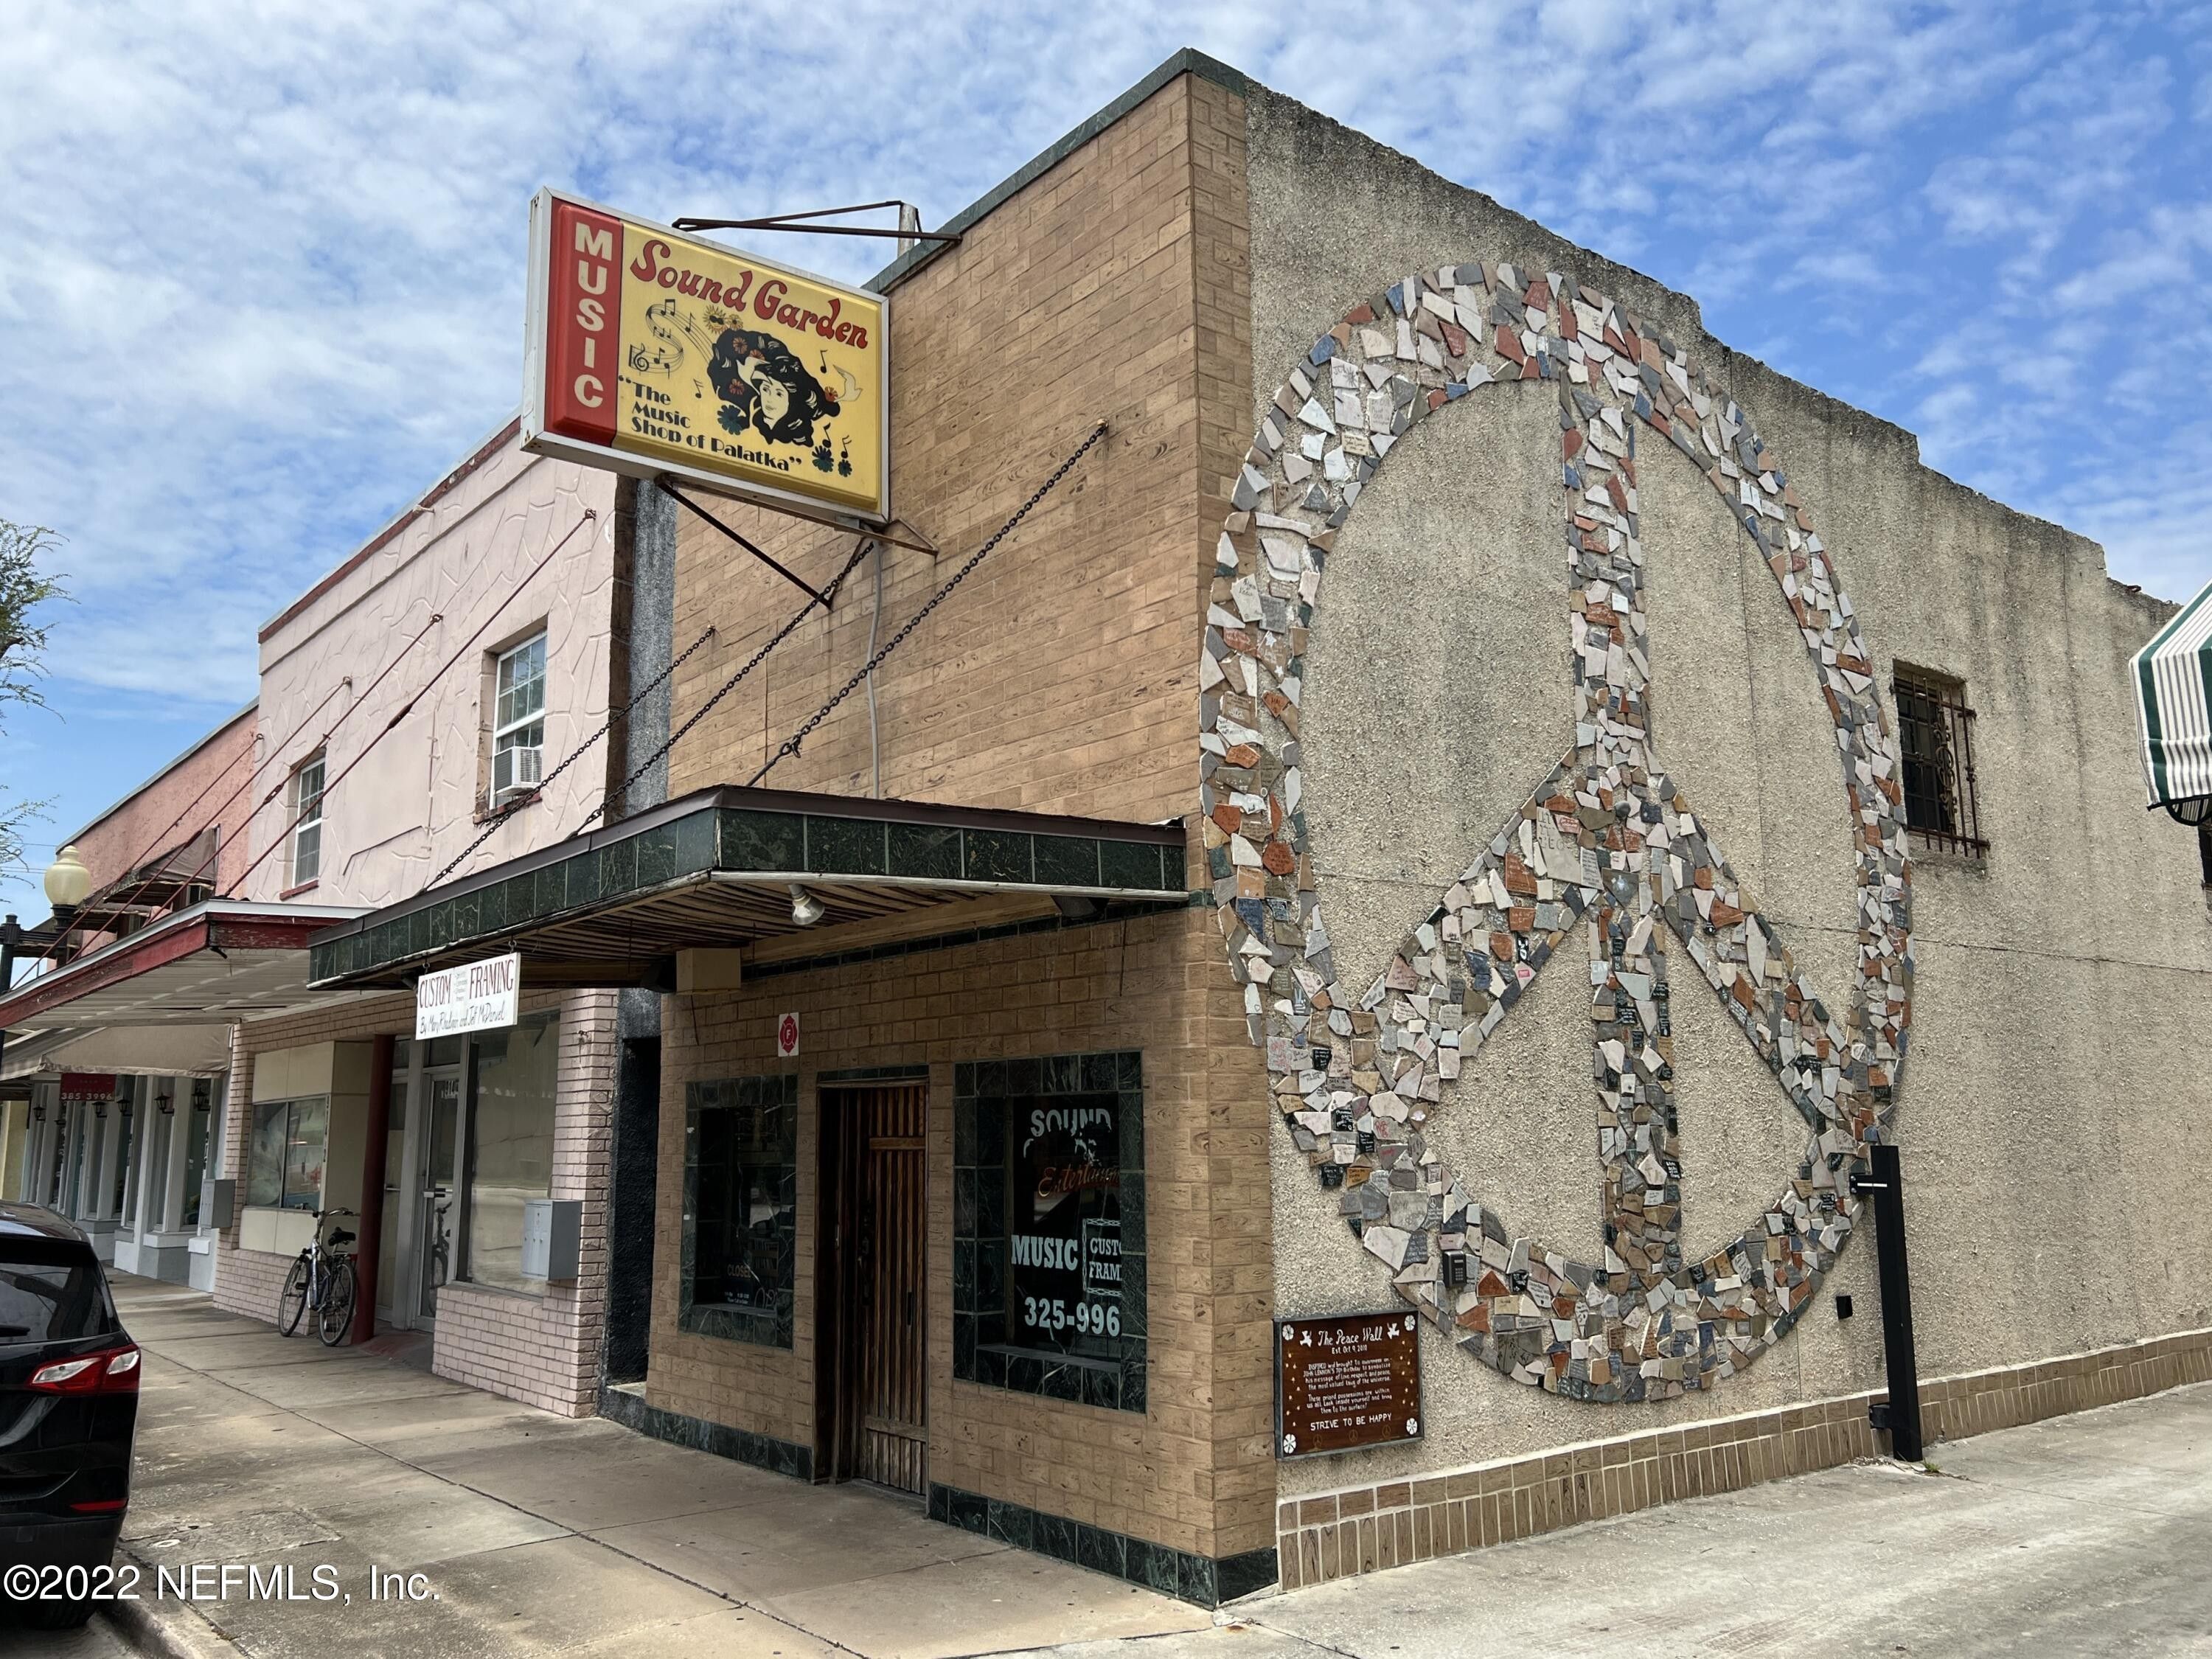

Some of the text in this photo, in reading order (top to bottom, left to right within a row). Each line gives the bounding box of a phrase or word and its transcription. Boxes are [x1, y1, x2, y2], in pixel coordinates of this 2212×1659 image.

[630, 240, 869, 349] Sound Garden
[574, 222, 613, 408] MUSIC
[632, 401, 691, 428] Music
[631, 417, 681, 445] Shop
[687, 434, 706, 449] of
[420, 974, 451, 1008] CUSTOM
[469, 959, 515, 1000] FRAMING
[786, 1029, 791, 1040] F
[61, 1092, 112, 1101] 385 3996
[1011, 1235, 1078, 1270] MUSIC
[1089, 1261, 1121, 1281] FRAM
[1025, 1297, 1120, 1337] 325-996
[1318, 1326, 1382, 1346] The Peace Wall
[1310, 1413, 1392, 1431] STRIVE TO BE HAPPY
